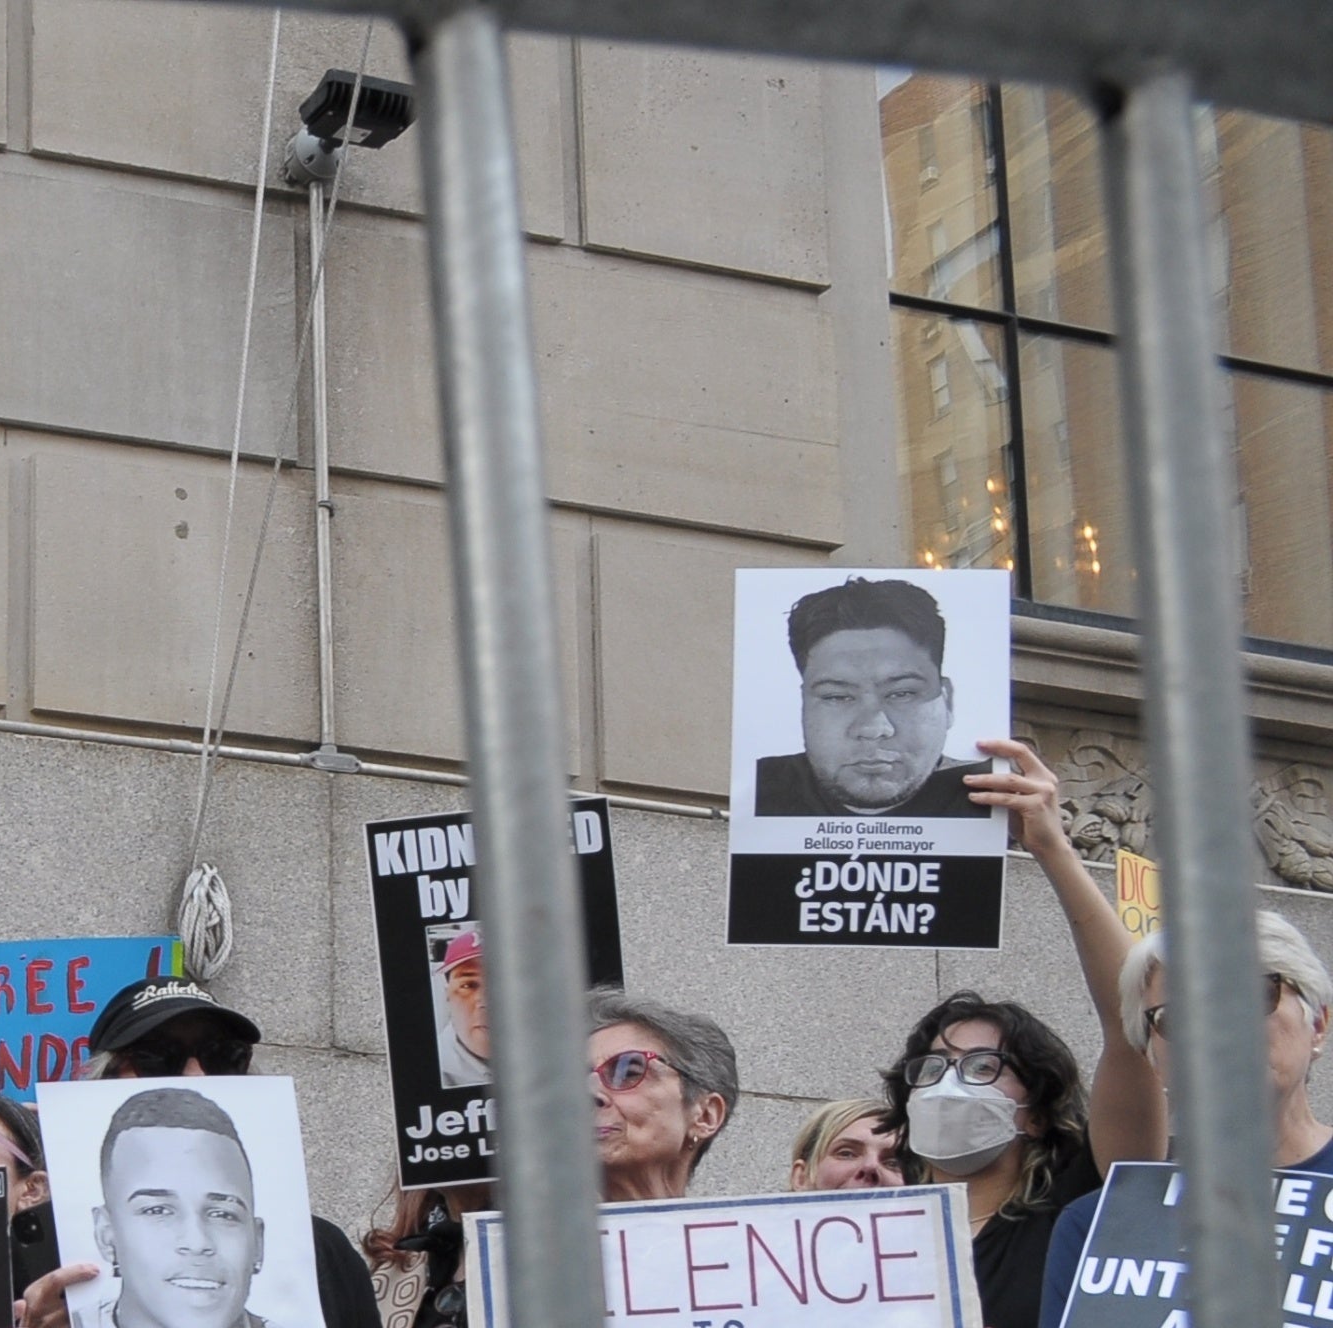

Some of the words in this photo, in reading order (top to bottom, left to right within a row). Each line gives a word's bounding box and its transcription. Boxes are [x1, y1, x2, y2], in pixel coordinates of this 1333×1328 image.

[374, 810, 603, 876] KIDND
[804, 837, 854, 850] Belloso
[858, 838, 935, 853] Fuenmayor
[817, 822, 853, 835] Alirio
[856, 822, 923, 836] Guillermo
[417, 875, 469, 919] by
[795, 854, 941, 899] ¿DÓNDE
[799, 891, 936, 935] ESTÁN?
[405, 1098, 496, 1139] Jeff
[407, 1144, 470, 1163] Jose
[601, 1209, 935, 1317] LENCE
